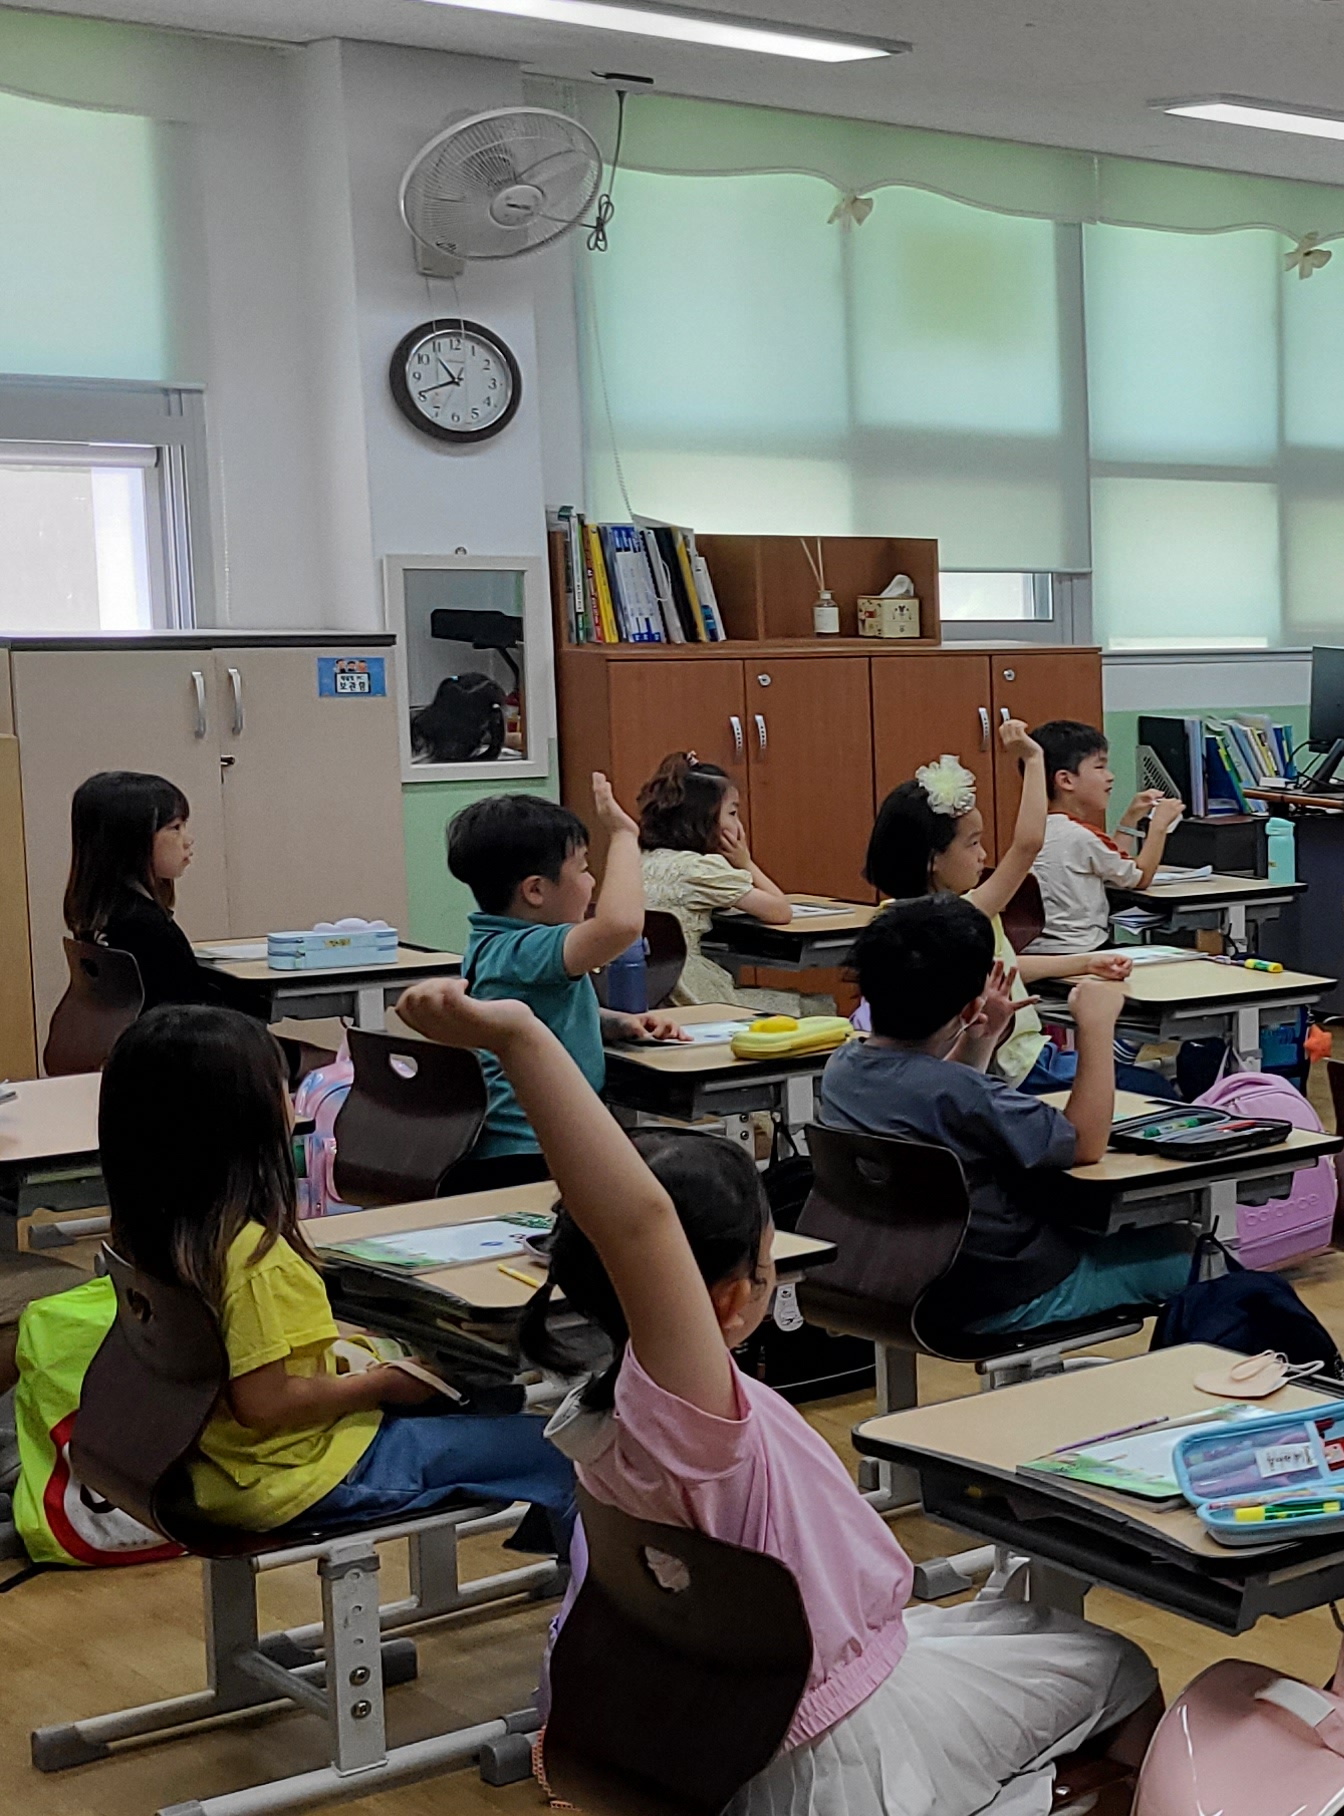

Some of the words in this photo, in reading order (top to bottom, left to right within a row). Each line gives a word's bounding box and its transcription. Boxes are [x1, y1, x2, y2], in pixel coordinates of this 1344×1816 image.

[432, 341, 441, 353] 11
[450, 338, 462, 351] 12
[417, 353, 430, 365] 10
[482, 358, 491, 371] 2
[412, 371, 422, 381] 9
[488, 377, 497, 390] 3
[483, 395, 491, 407] 4
[432, 405, 441, 418] 7
[451, 411, 460, 423] 6
[471, 407, 480, 420] 5
